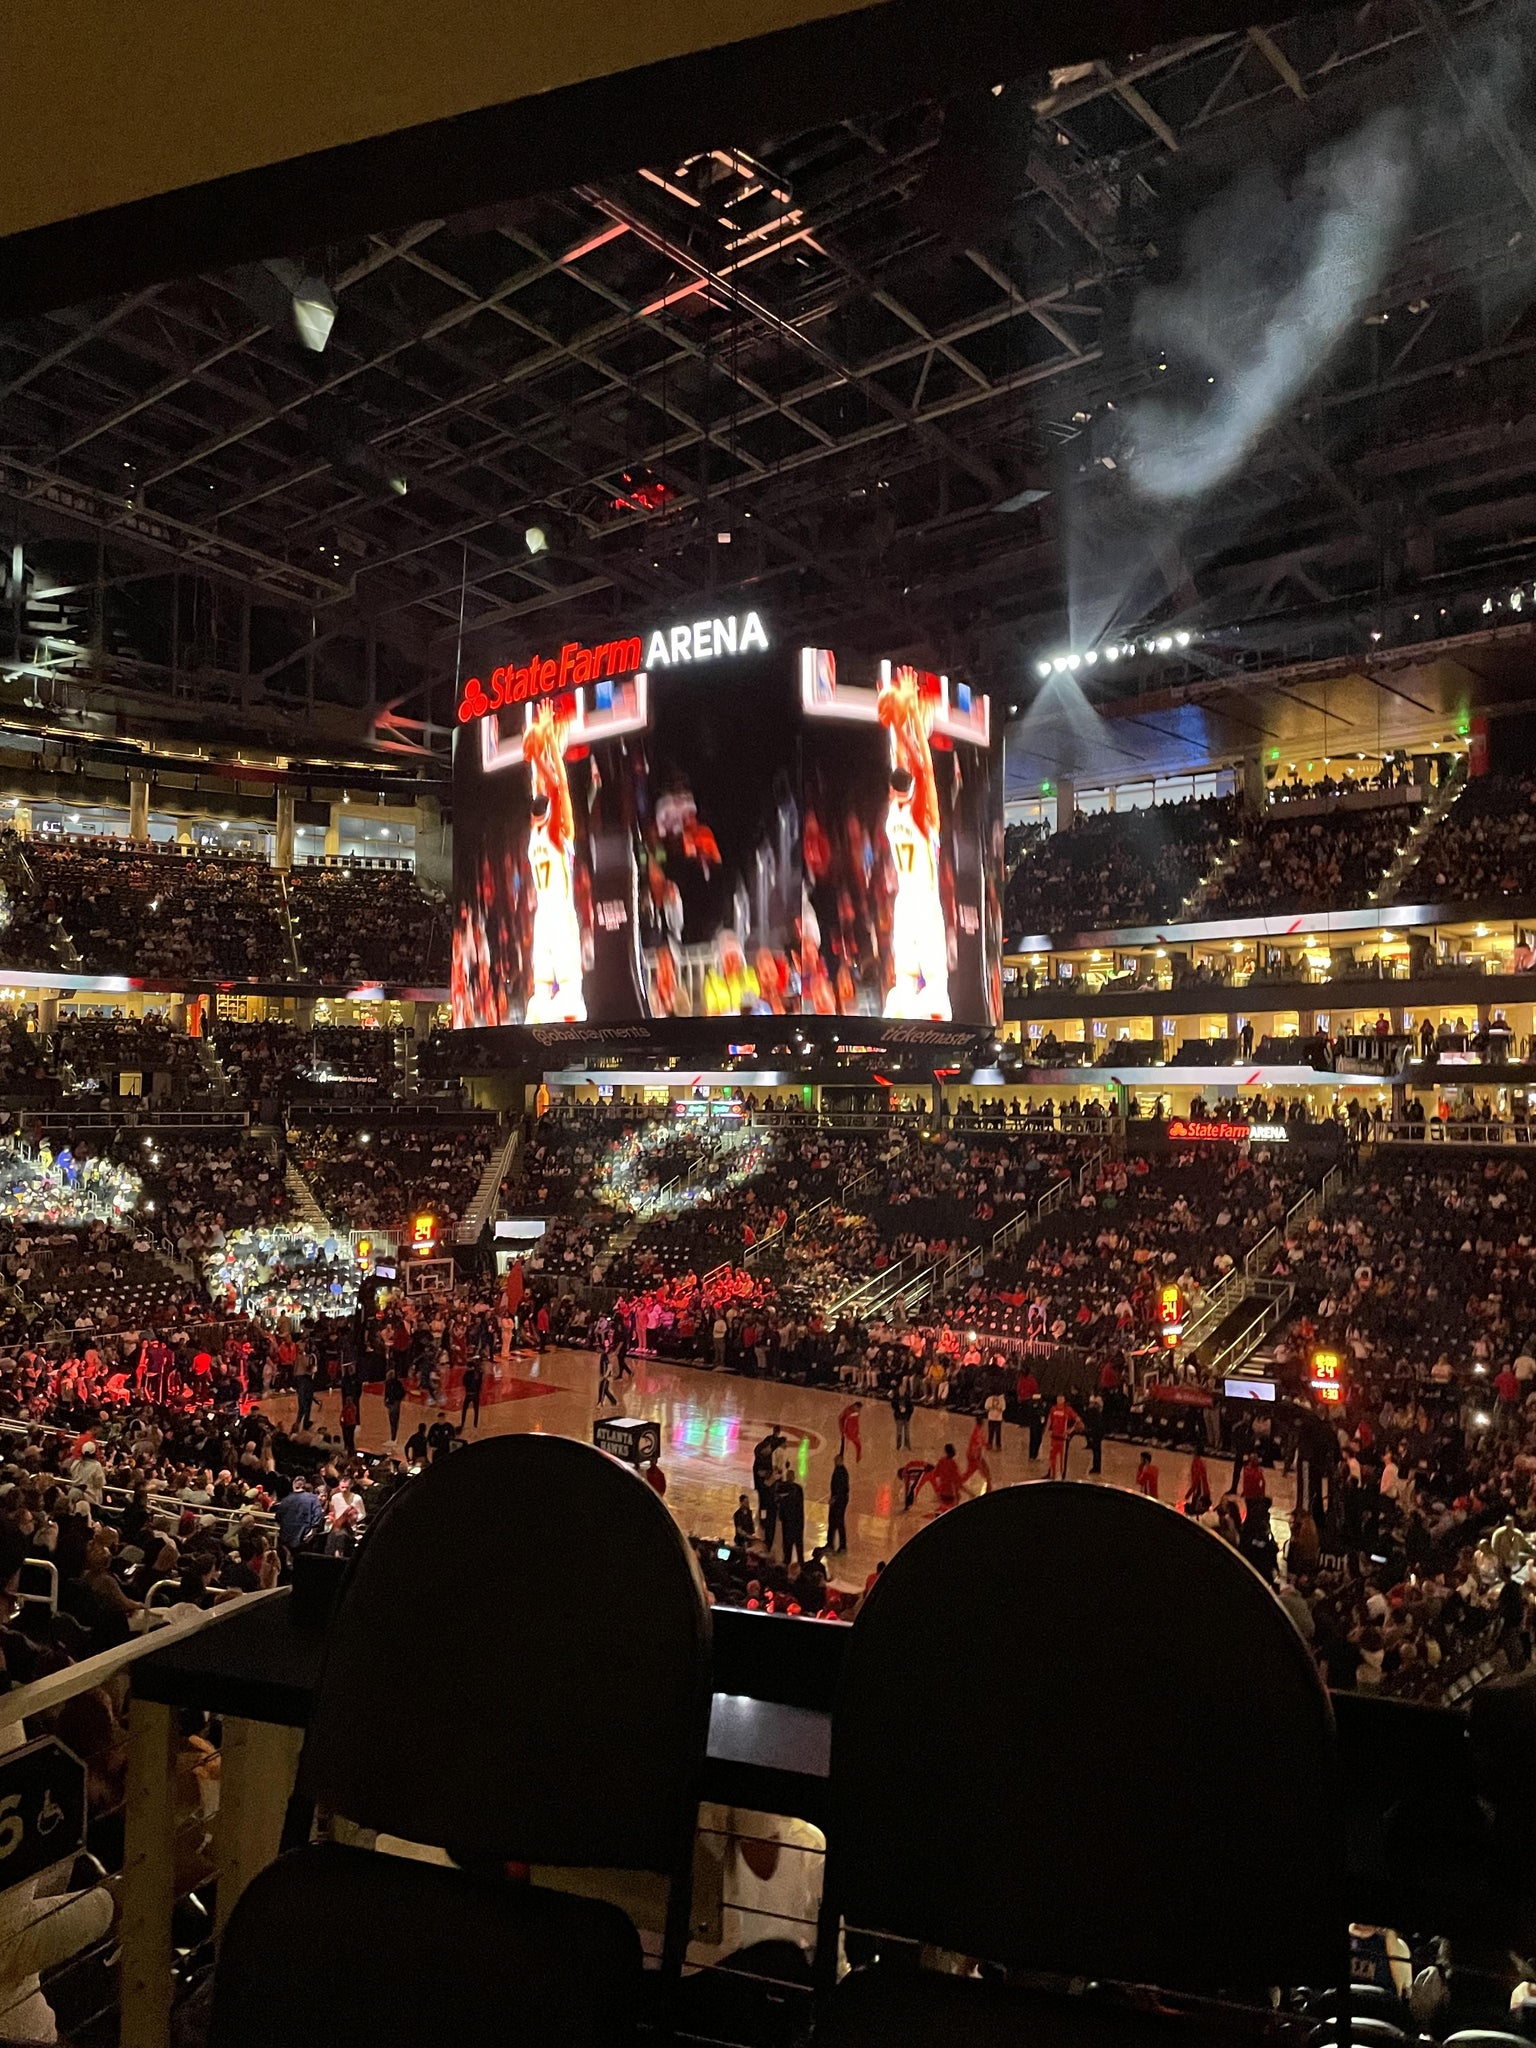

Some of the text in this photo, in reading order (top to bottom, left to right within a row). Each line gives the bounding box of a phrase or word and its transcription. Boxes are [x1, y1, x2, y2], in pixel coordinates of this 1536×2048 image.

[646, 612, 769, 669] ARENA
[880, 1025, 977, 1046] ticketmaster
[1250, 1126, 1287, 1139] ARENA
[415, 1225, 432, 1241] 24
[1162, 1301, 1177, 1322] 24
[1317, 1365, 1335, 1378] 24
[596, 1427, 634, 1446] ATLANTA
[600, 1440, 630, 1457] HAWKS
